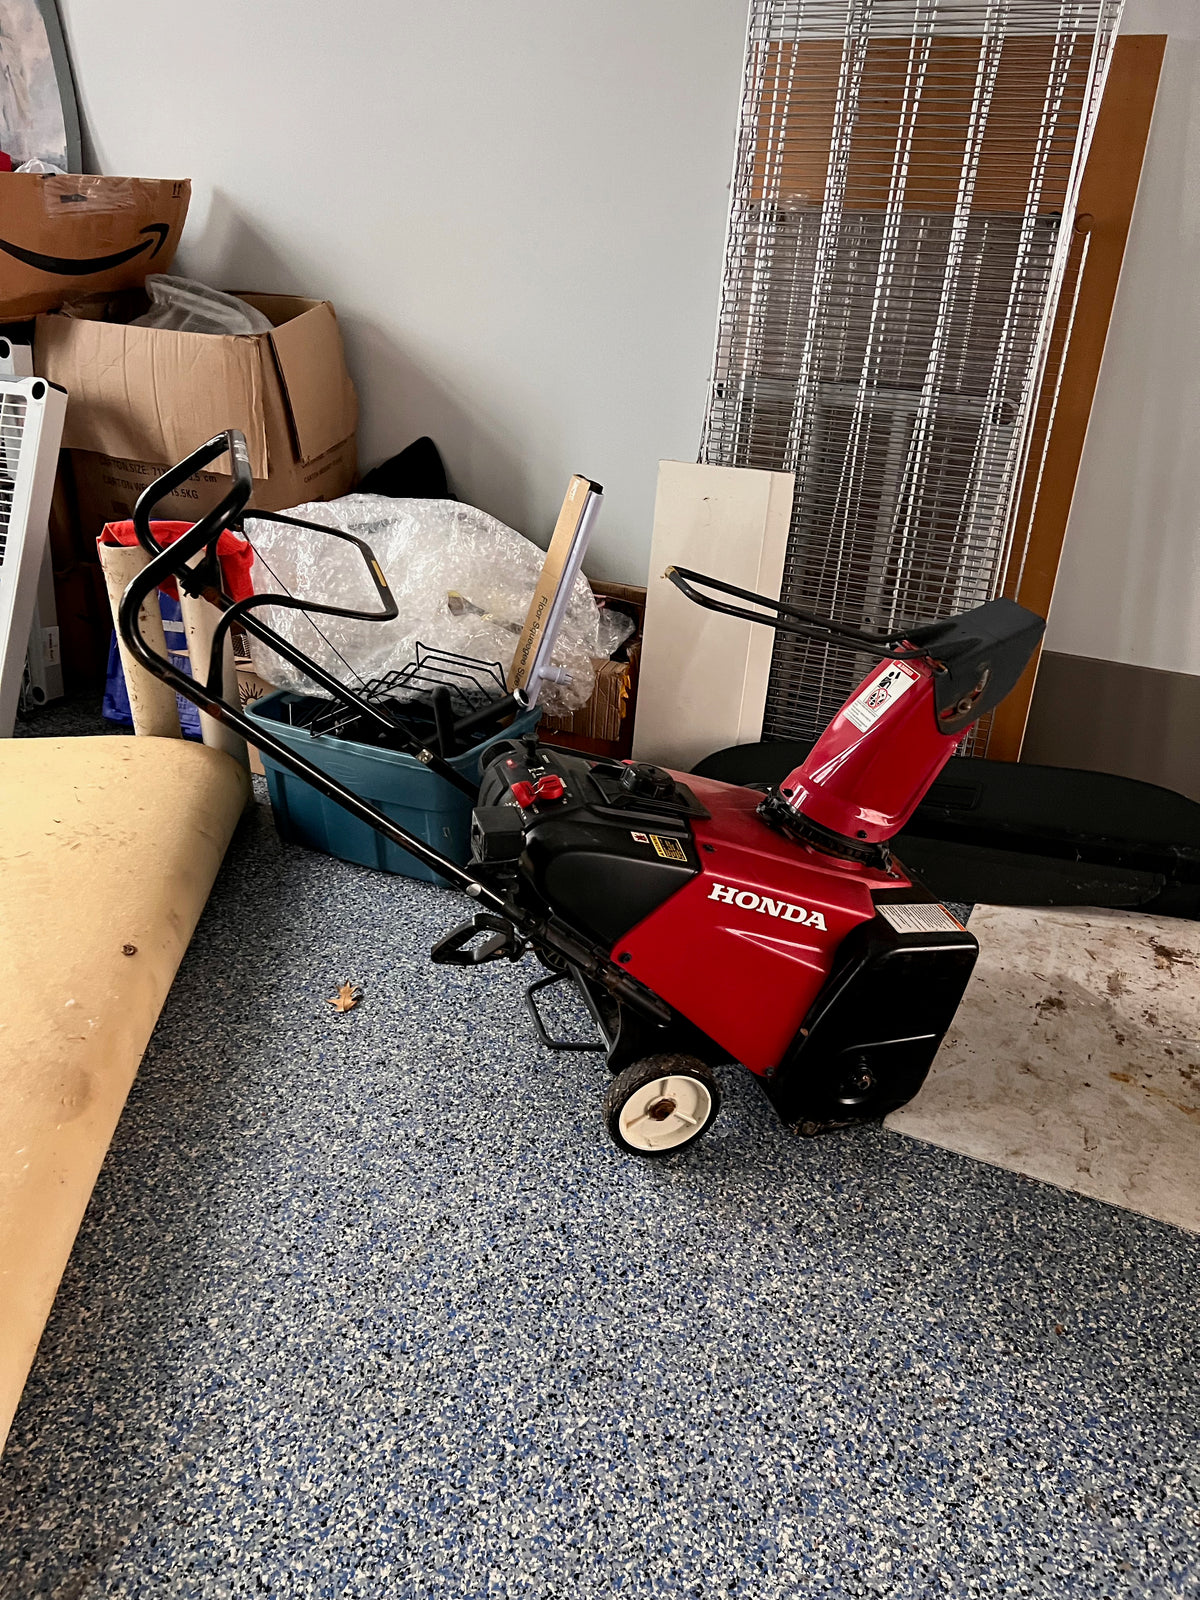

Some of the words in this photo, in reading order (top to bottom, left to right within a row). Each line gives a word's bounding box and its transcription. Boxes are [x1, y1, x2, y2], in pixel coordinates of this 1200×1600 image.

[204, 474, 217, 483] cm
[535, 595, 549, 620] Floor
[520, 620, 541, 666] Squeegee
[707, 883, 828, 932] HONDA
